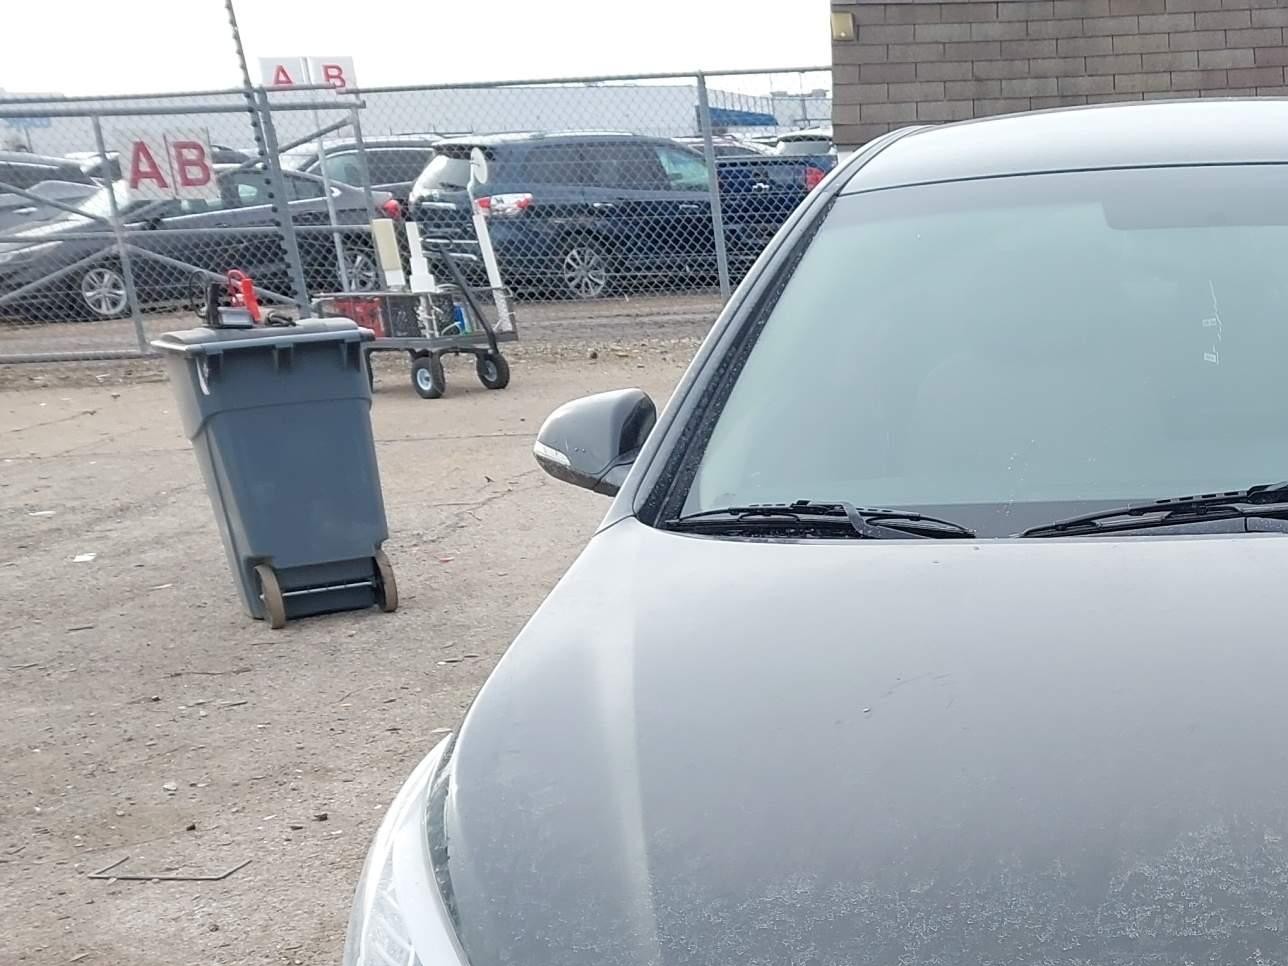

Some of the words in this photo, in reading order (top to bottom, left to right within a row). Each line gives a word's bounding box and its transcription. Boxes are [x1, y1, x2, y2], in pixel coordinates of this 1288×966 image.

[323, 64, 346, 88] B
[129, 140, 169, 189] A
[173, 140, 211, 187] B
